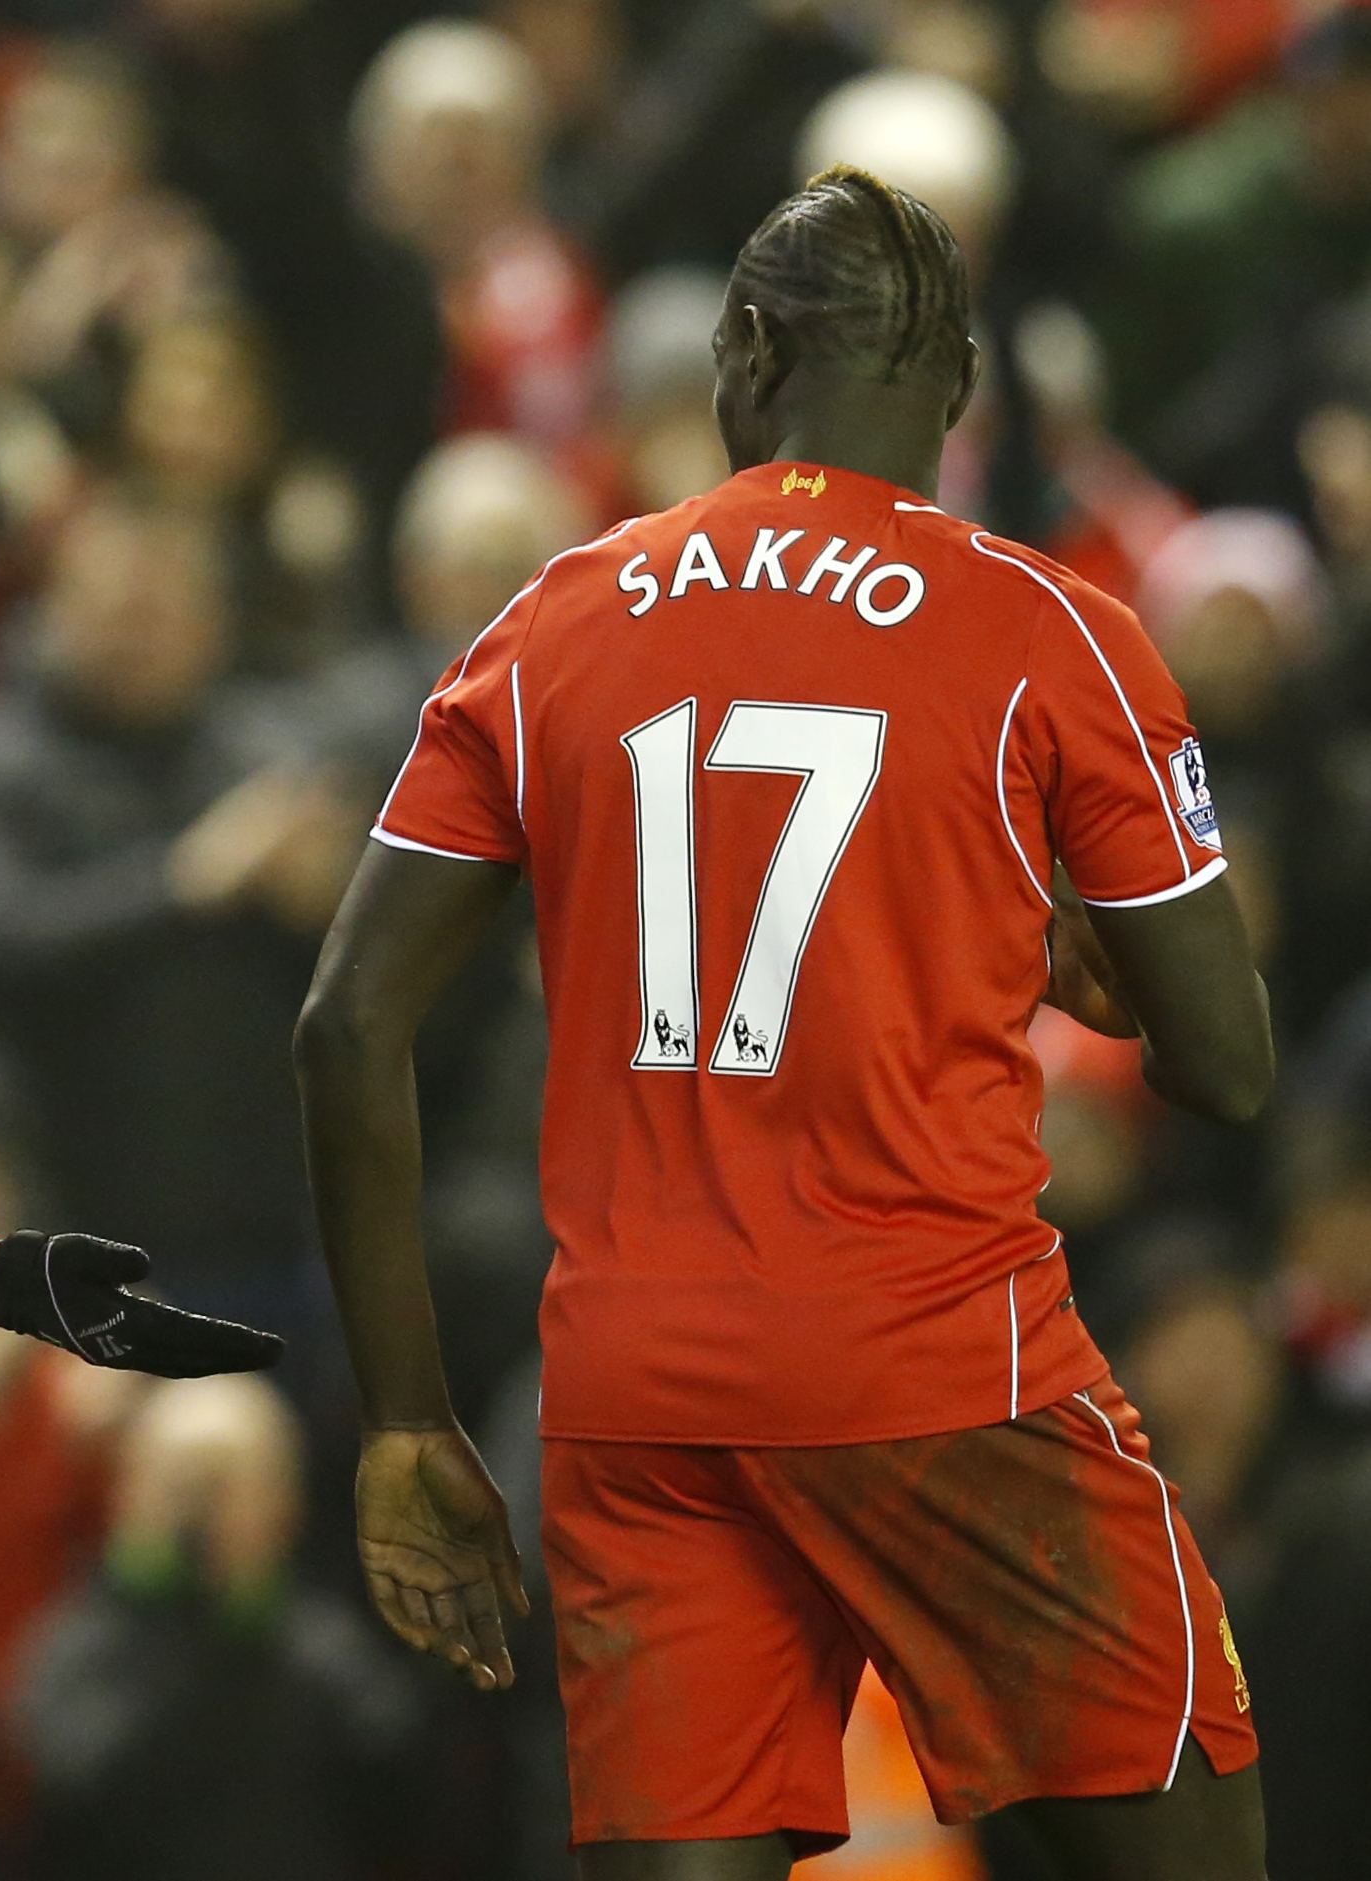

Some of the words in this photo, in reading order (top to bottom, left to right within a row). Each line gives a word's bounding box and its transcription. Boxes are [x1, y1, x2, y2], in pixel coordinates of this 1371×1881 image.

[796, 477, 814, 490] 96
[618, 528, 926, 628] SAKHO
[619, 696, 888, 1077] 17
